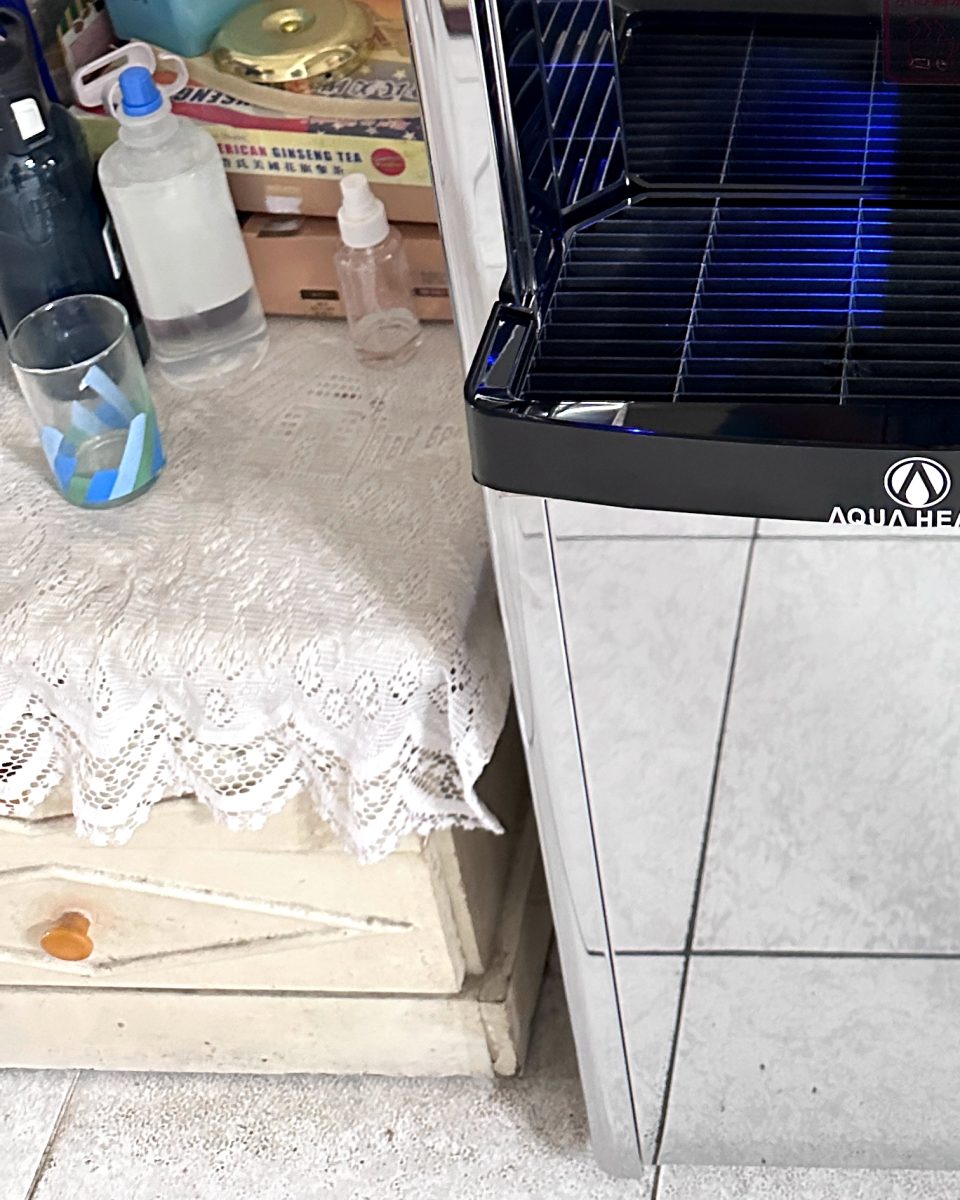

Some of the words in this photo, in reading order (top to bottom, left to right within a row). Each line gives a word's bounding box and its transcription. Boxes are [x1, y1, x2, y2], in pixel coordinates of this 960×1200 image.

[271, 146, 333, 161] GINSENG
[336, 150, 363, 163] TEA
[828, 506, 906, 528] AQUA
